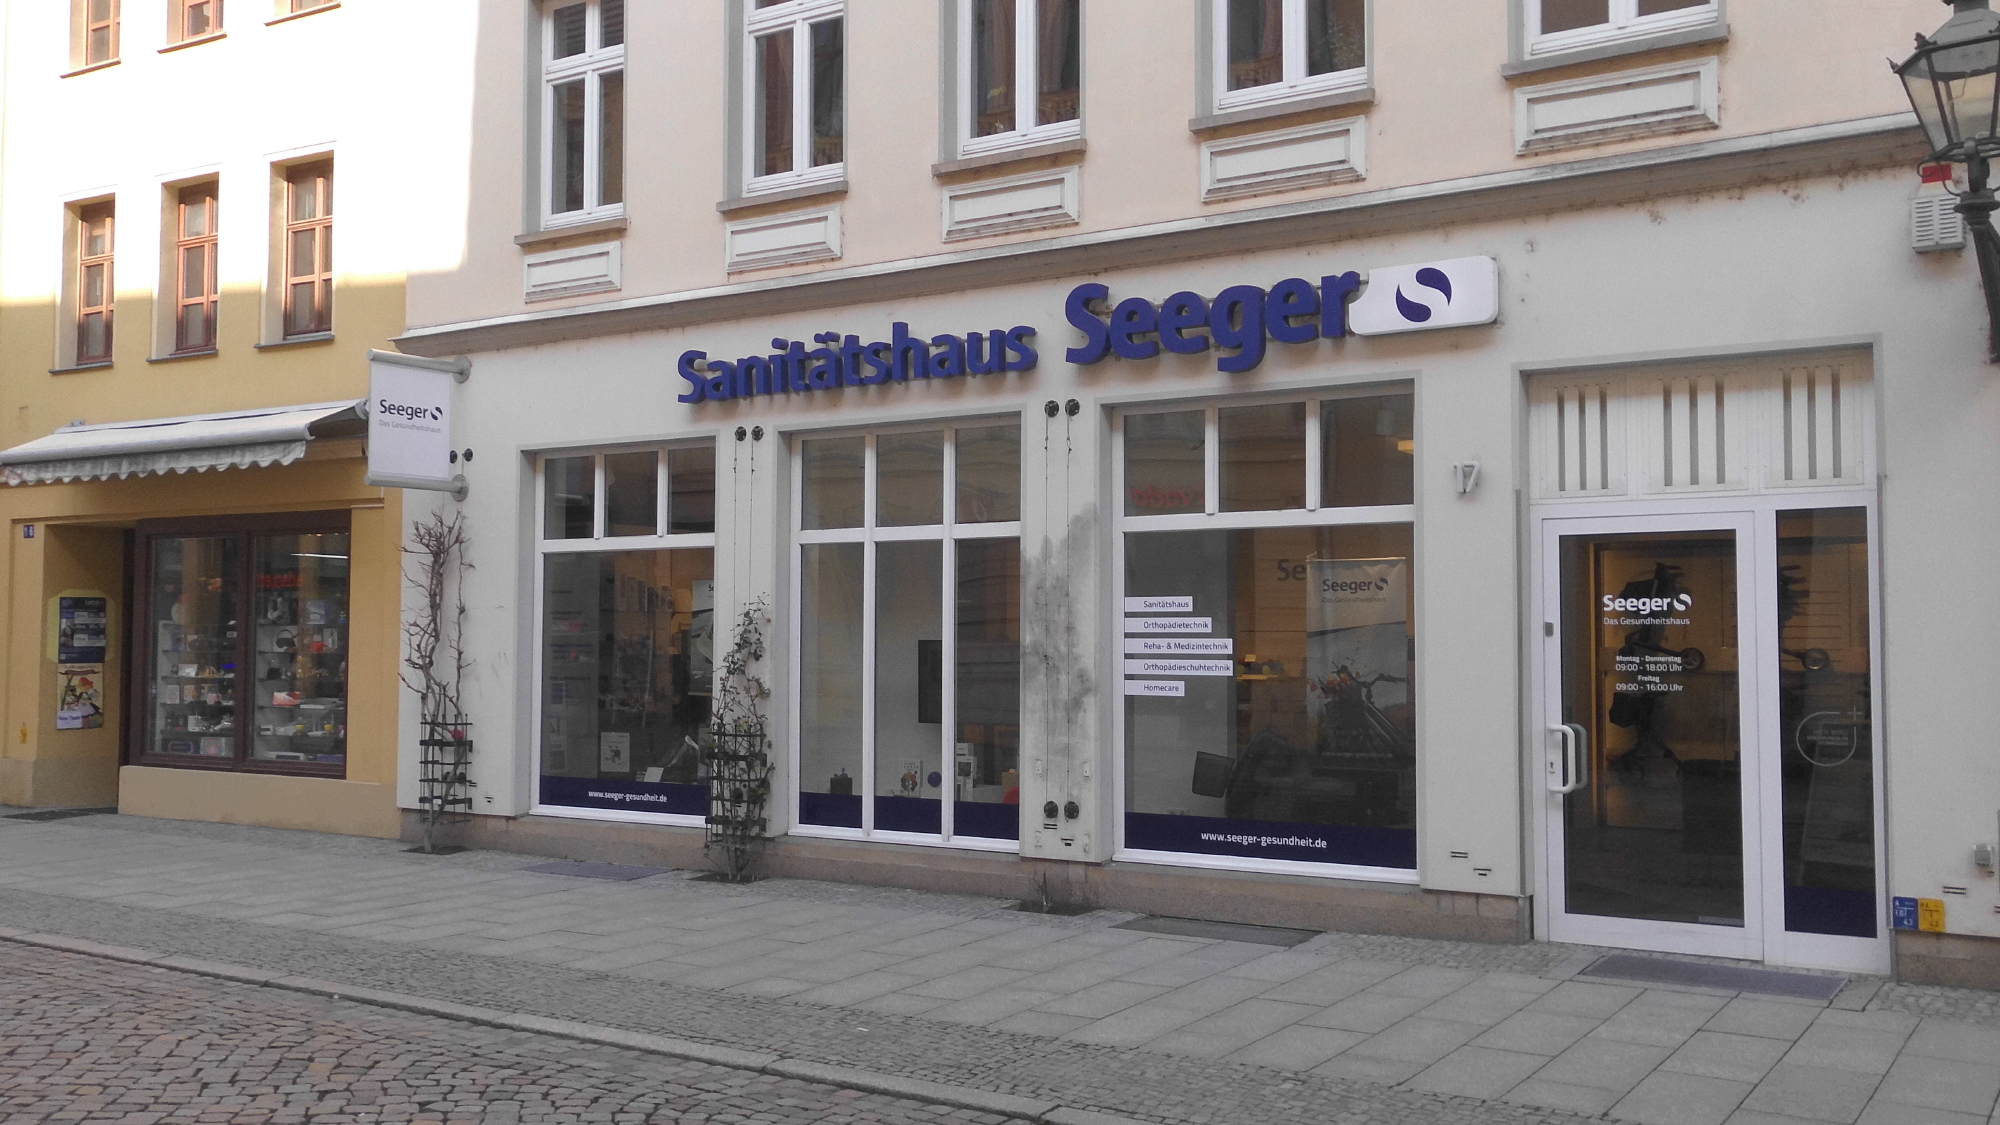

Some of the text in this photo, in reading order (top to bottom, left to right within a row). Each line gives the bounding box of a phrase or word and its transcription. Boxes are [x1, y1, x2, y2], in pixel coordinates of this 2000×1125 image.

[677, 270, 1361, 404] Sanitätshaus Seeger
[379, 398, 429, 420] Seeger
[378, 419, 441, 434] Das Gesundheitshaus
[1453, 461, 1480, 493] 17
[1322, 578, 1372, 594] Seeger
[1143, 600, 1190, 608] Sanitätshaus
[1335, 596, 1387, 604] Gesundheitshaus
[1603, 594, 1672, 615] Seeger
[1603, 616, 1691, 625] Das Gesundheitshaus
[1143, 621, 1209, 631] Orthopädietechnik
[1143, 642, 1229, 650] Reha- & Medizintechnik
[1616, 655, 1640, 663] Montag
[1645, 655, 1682, 663] Donnerstag
[1143, 662, 1231, 672] Orthopädieschuhtechnik
[1615, 663, 1639, 671] 09:00
[1637, 675, 1660, 683] Freitag
[1143, 684, 1180, 692] Homecare
[1615, 683, 1639, 691] 09:00
[588, 790, 668, 803] www.seeger-gesundheit.de
[1201, 832, 1328, 848] www.seeger-gesundheit.de
